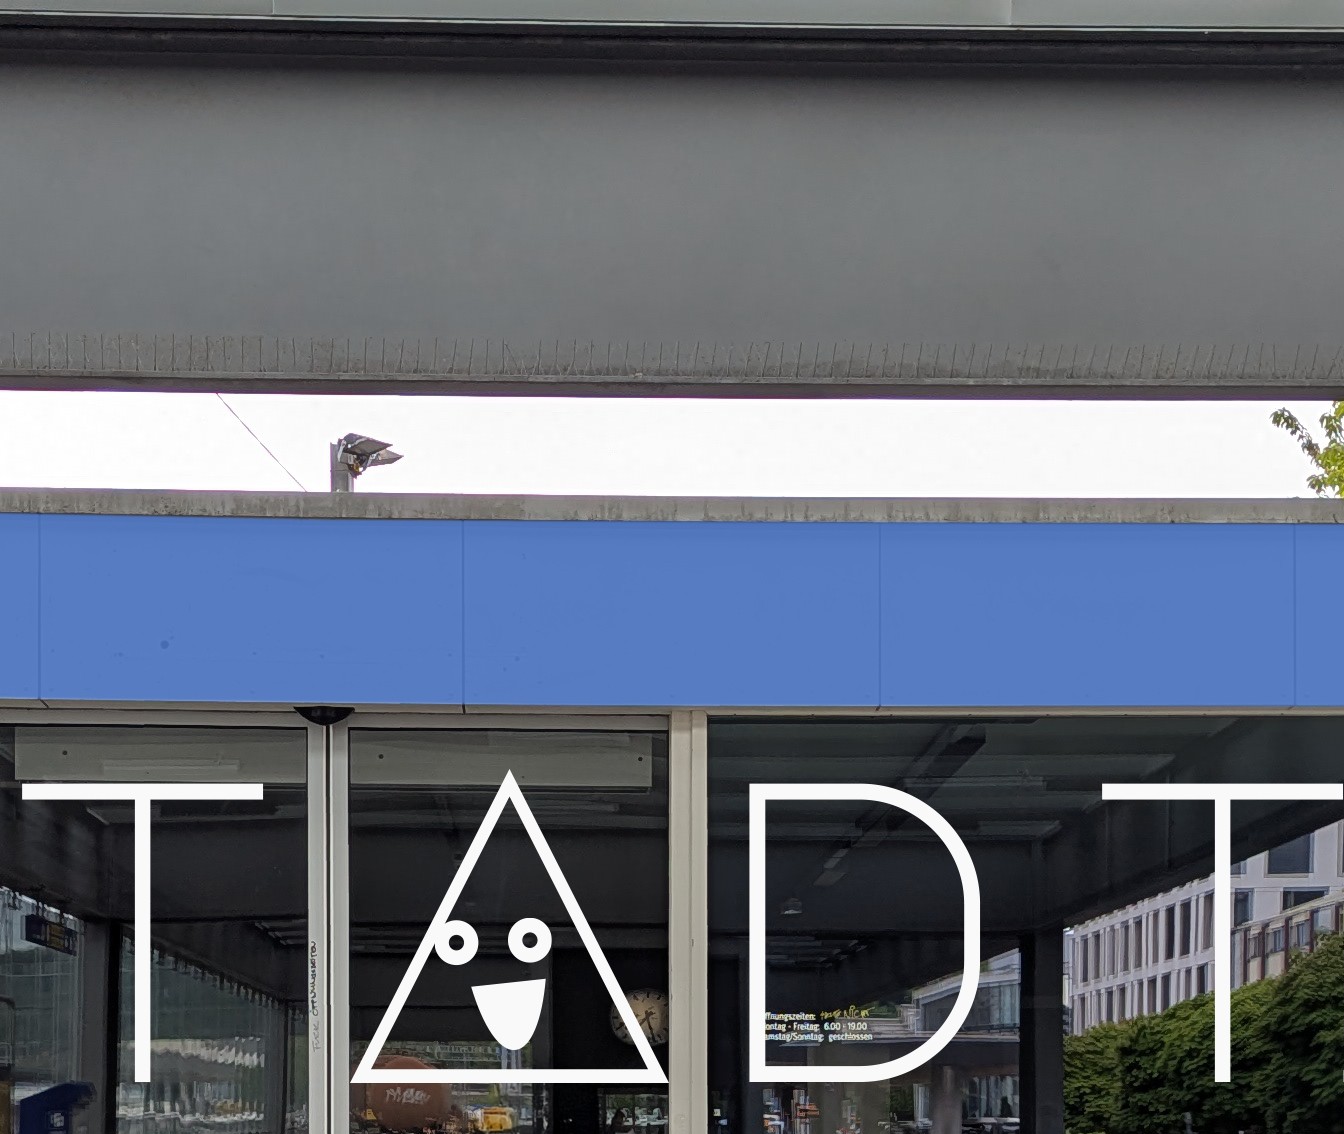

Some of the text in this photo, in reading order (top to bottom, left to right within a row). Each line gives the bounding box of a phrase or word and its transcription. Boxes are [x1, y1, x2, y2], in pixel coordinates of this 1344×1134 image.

[765, 1011, 816, 1022] ffnungszeiten:
[765, 1023, 786, 1032] ontag
[765, 1033, 873, 1042] amstag/Sonntag: geschlossen
